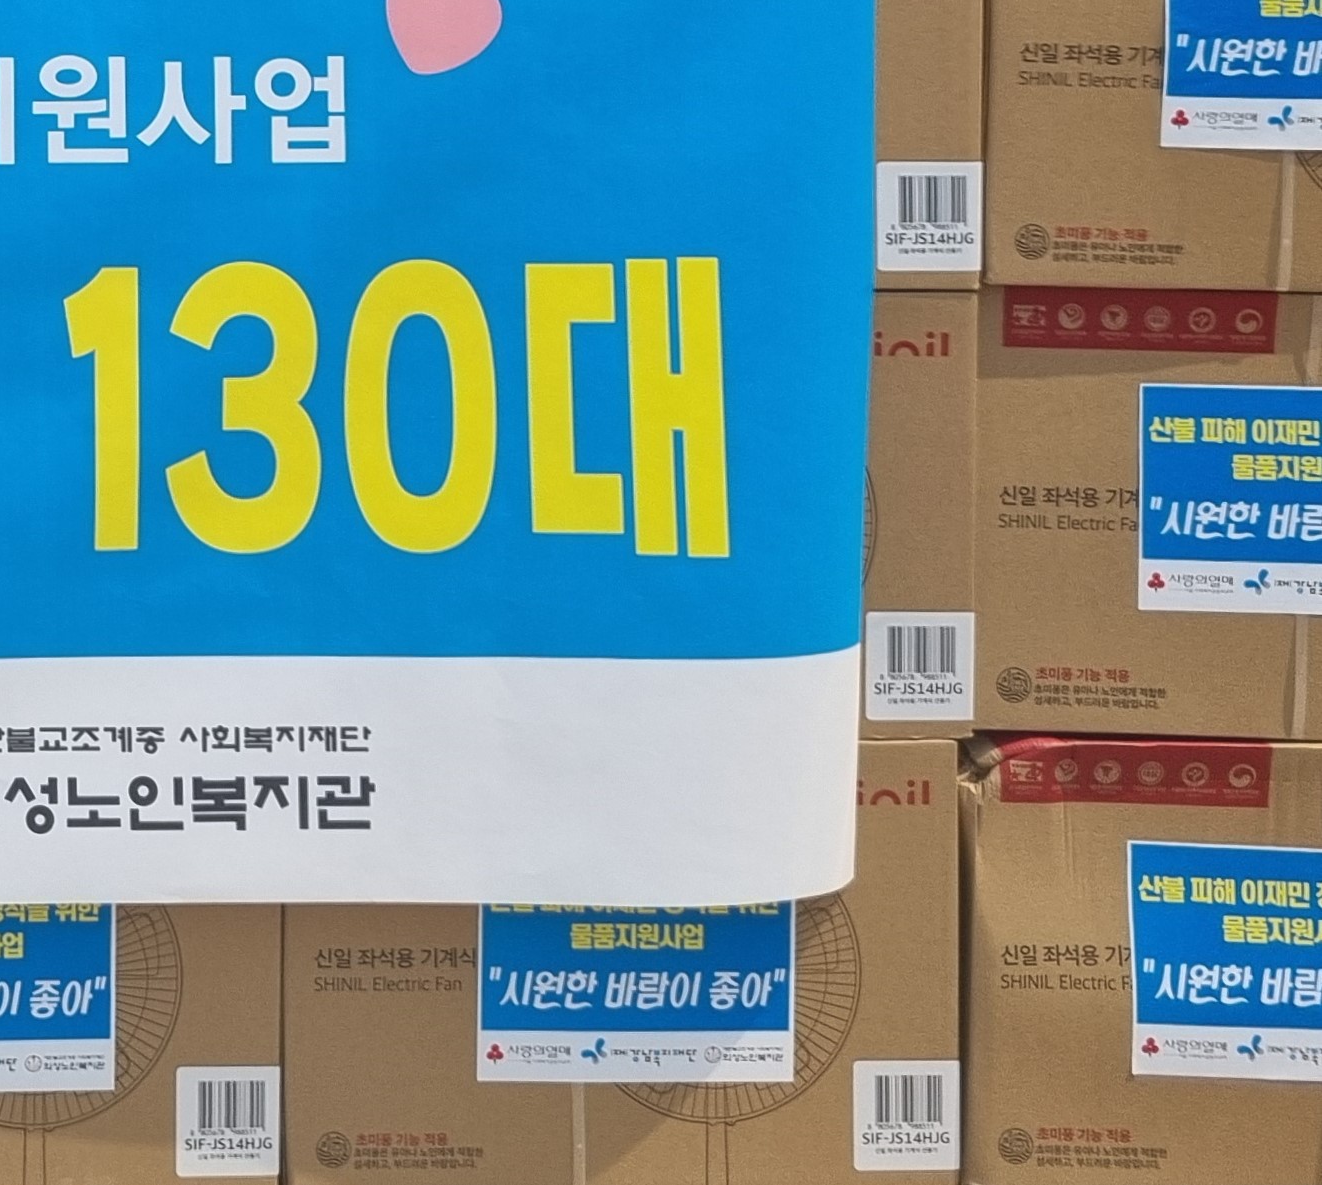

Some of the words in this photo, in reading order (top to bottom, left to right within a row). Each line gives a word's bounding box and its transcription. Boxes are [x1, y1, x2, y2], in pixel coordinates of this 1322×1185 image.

[1019, 42, 1059, 65] 신일
[1064, 44, 1123, 66] 좌석용
[1176, 33, 1287, 76] "시원한
[1142, 74, 1163, 90] Fa
[885, 232, 975, 245] SIF-JS14HJG
[66, 257, 729, 556] 130대
[1149, 416, 1195, 443] 산불
[1201, 417, 1246, 444] 피해
[1252, 419, 1320, 446] 이재민
[1232, 454, 1322, 482] 물품지원
[998, 485, 1036, 507] 신일
[1042, 486, 1099, 508] 좌석용
[998, 513, 1052, 530] SHINIL
[1057, 514, 1116, 531] Electric
[1120, 516, 1138, 532] Fa
[1150, 496, 1260, 540] "시원한
[874, 682, 963, 695] SIF-JS14HJG
[180, 726, 371, 752] 사회복지재단
[1138, 874, 1185, 903] 산불
[1190, 876, 1236, 905] 피해
[1241, 878, 1310, 908] 이재민
[570, 922, 704, 950] 물품지원사업
[315, 947, 351, 969] 신일
[357, 947, 414, 969] 좌석용
[420, 947, 477, 969] 기계식
[1001, 944, 1038, 966] 신일
[1043, 944, 1099, 967] 좌석용
[314, 976, 367, 992] SHINIL
[372, 976, 431, 992] Electric
[436, 976, 462, 992] Fan
[489, 966, 598, 1010] "시원한
[604, 970, 702, 1009] 바람이
[709, 967, 785, 1010] 좋아"
[1000, 974, 1054, 990] SHINIL
[1059, 974, 1117, 991] Electric
[1143, 958, 1253, 1004] "시원한
[1260, 967, 1322, 1007] 바람
[30, 976, 106, 1019] 좋아"
[185, 1137, 273, 1151] SIF-JS14HJG
[862, 1131, 950, 1145] SIF-JS14HJG
